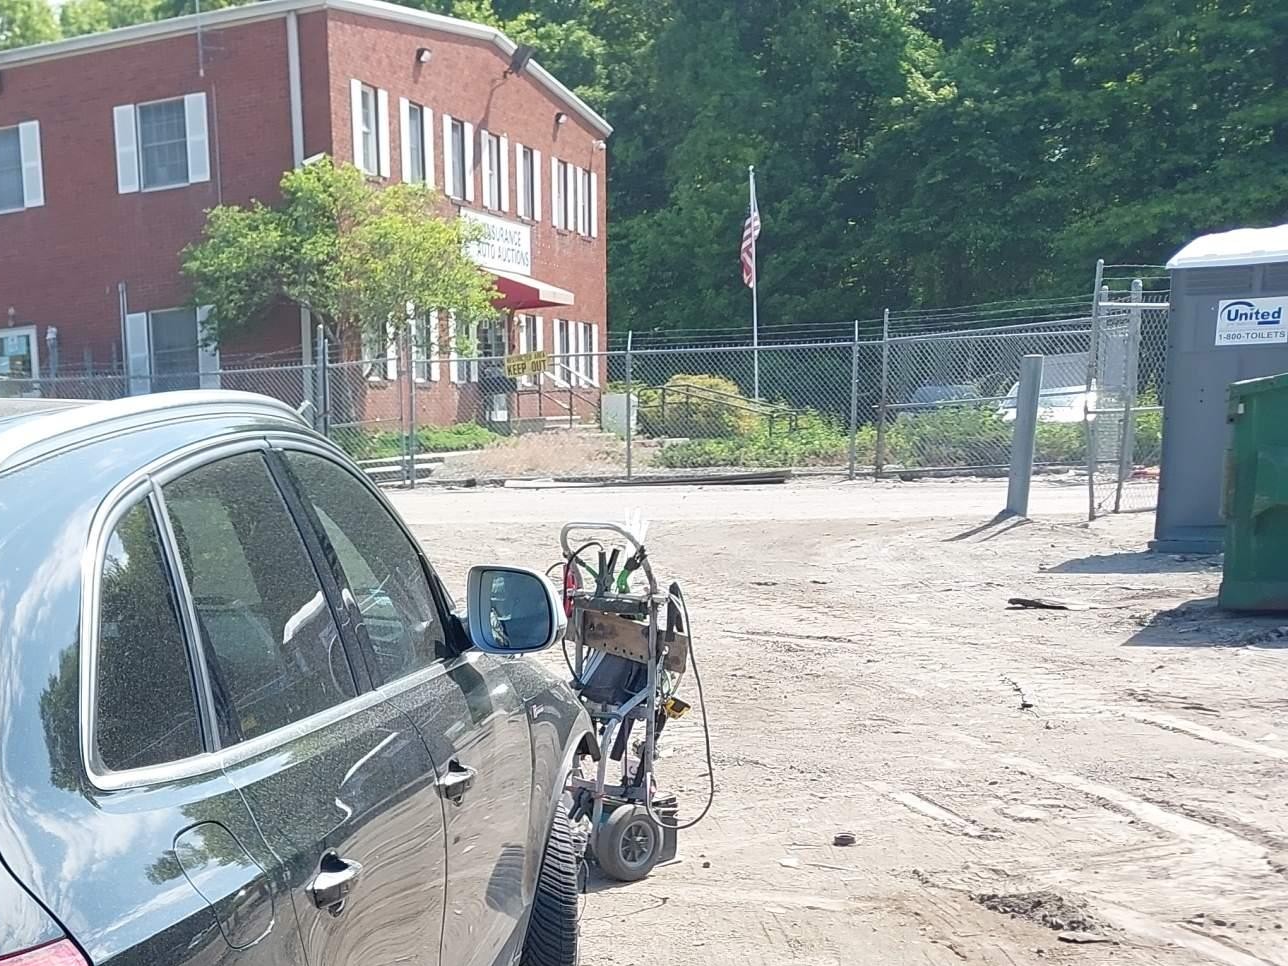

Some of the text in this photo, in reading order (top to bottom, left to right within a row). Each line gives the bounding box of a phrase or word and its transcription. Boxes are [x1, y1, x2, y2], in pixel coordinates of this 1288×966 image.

[497, 245, 529, 267] AUCTIONS
[1227, 307, 1281, 321] United
[1219, 331, 1285, 340] 1-800-TOILETS
[507, 360, 546, 376] KEEP OUT
